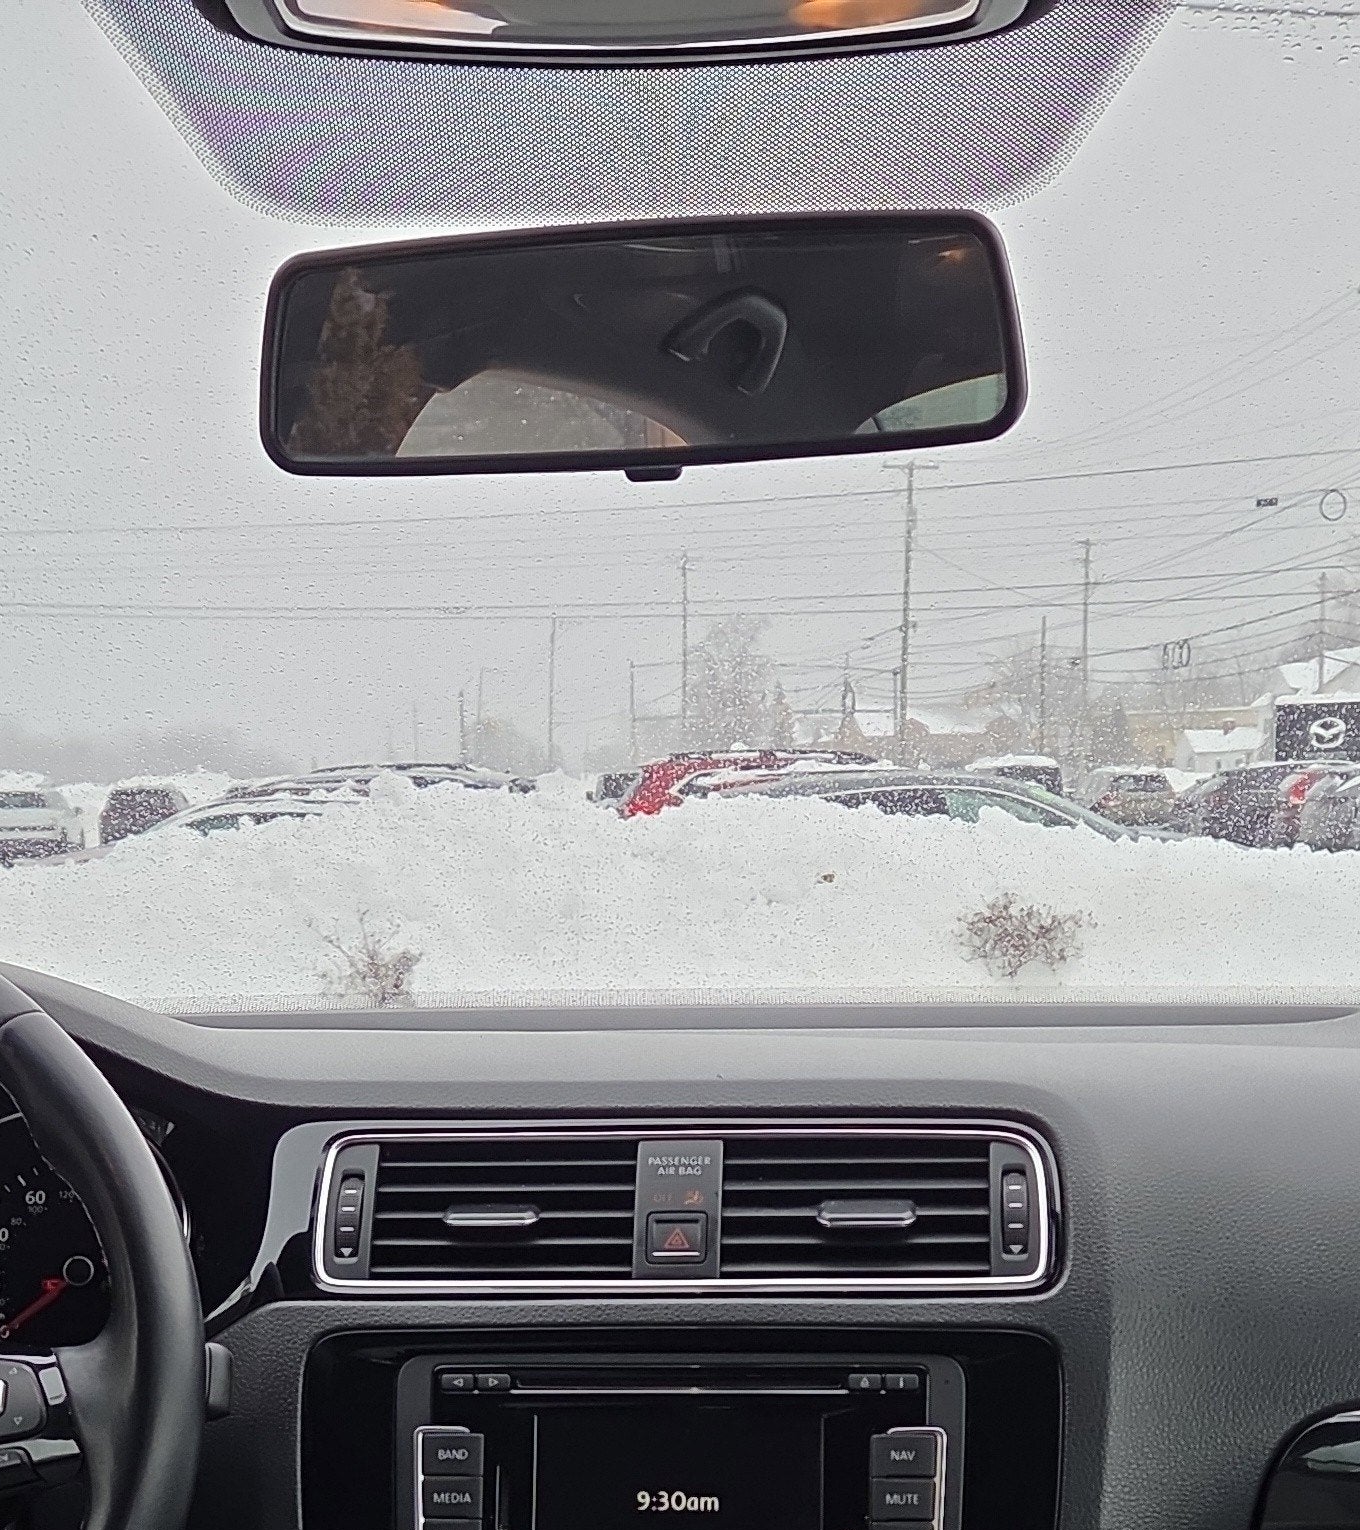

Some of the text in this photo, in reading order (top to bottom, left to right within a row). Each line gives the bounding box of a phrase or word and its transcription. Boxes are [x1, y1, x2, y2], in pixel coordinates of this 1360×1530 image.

[648, 1156, 711, 1166] PASSENGER
[657, 1166, 702, 1176] AIR BAG
[25, 1190, 46, 1205] 60
[437, 1448, 469, 1460] BAND
[890, 1450, 915, 1461] NAV
[433, 1492, 472, 1504] MEDIA
[636, 1490, 720, 1512] 9:30am
[885, 1493, 919, 1505] MUTE
